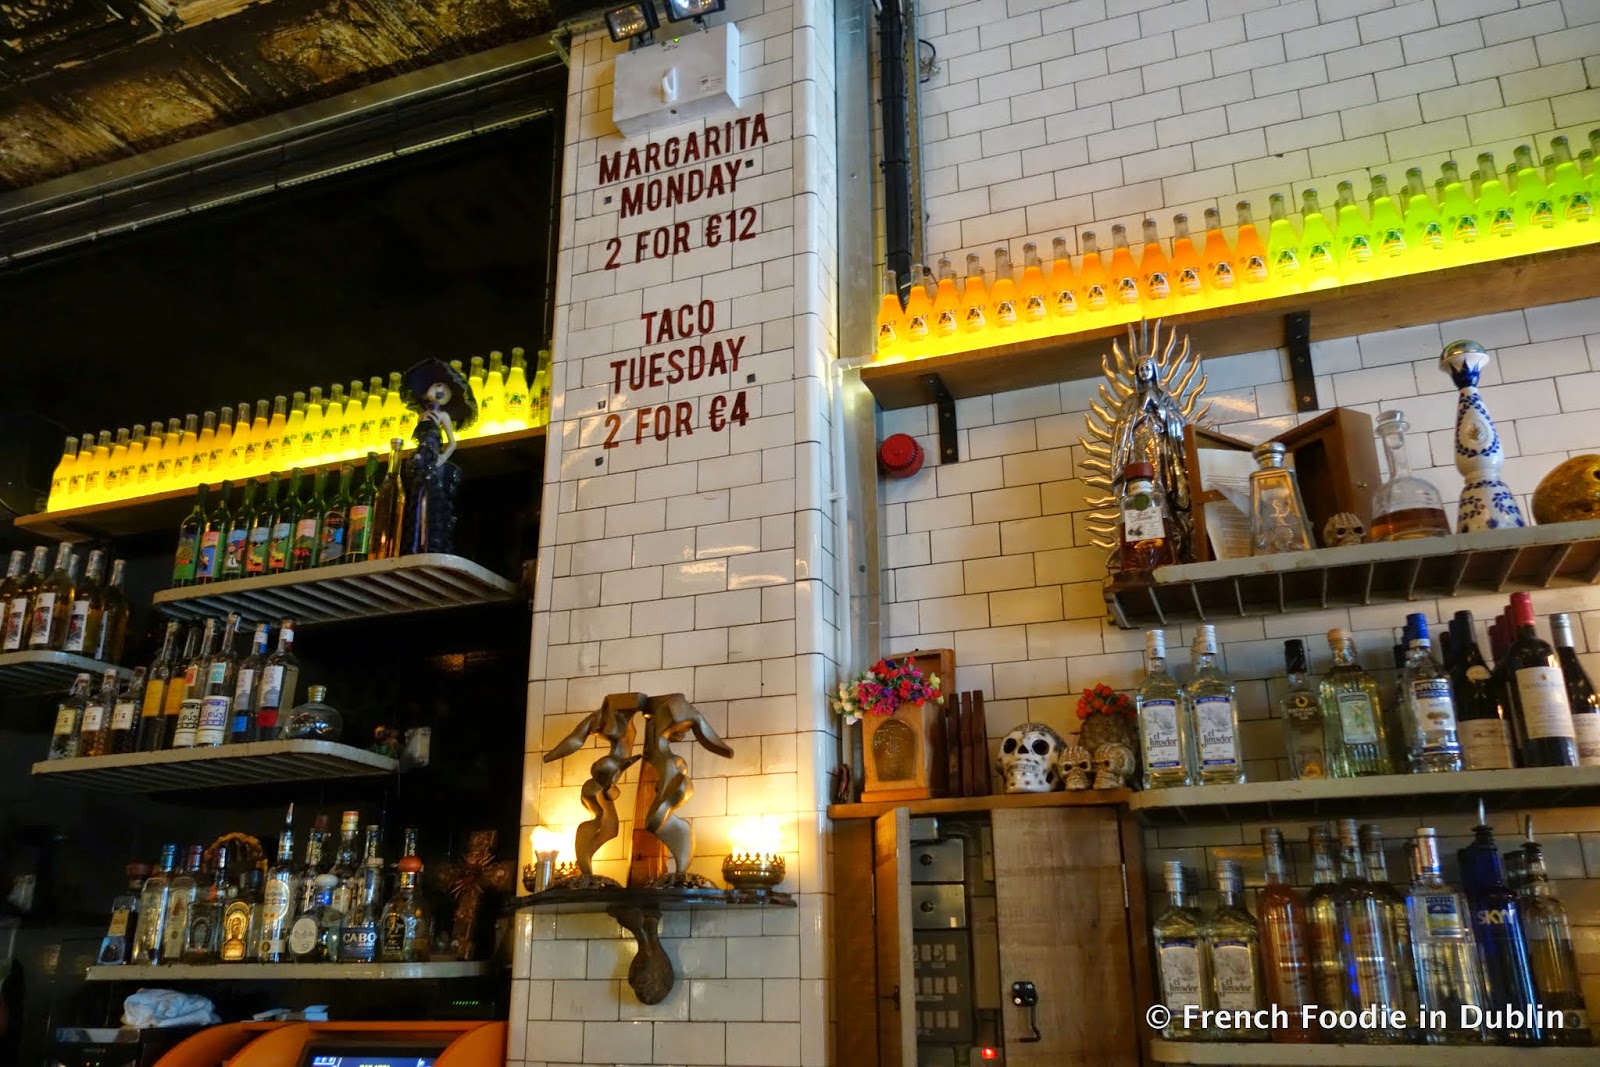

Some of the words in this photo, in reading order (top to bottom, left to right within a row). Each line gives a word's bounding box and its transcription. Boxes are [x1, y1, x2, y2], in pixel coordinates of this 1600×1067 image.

[598, 112, 768, 185] MARGARITA
[619, 159, 742, 219] MONDAY
[603, 238, 622, 271] 2
[635, 220, 691, 264] FOR
[705, 206, 757, 248] €12
[640, 299, 715, 346] TACO
[609, 335, 746, 395] TUESDAY
[602, 413, 622, 449] 2
[634, 401, 694, 445] FOR
[708, 390, 750, 433] €4
[342, 932, 378, 943] CABO
